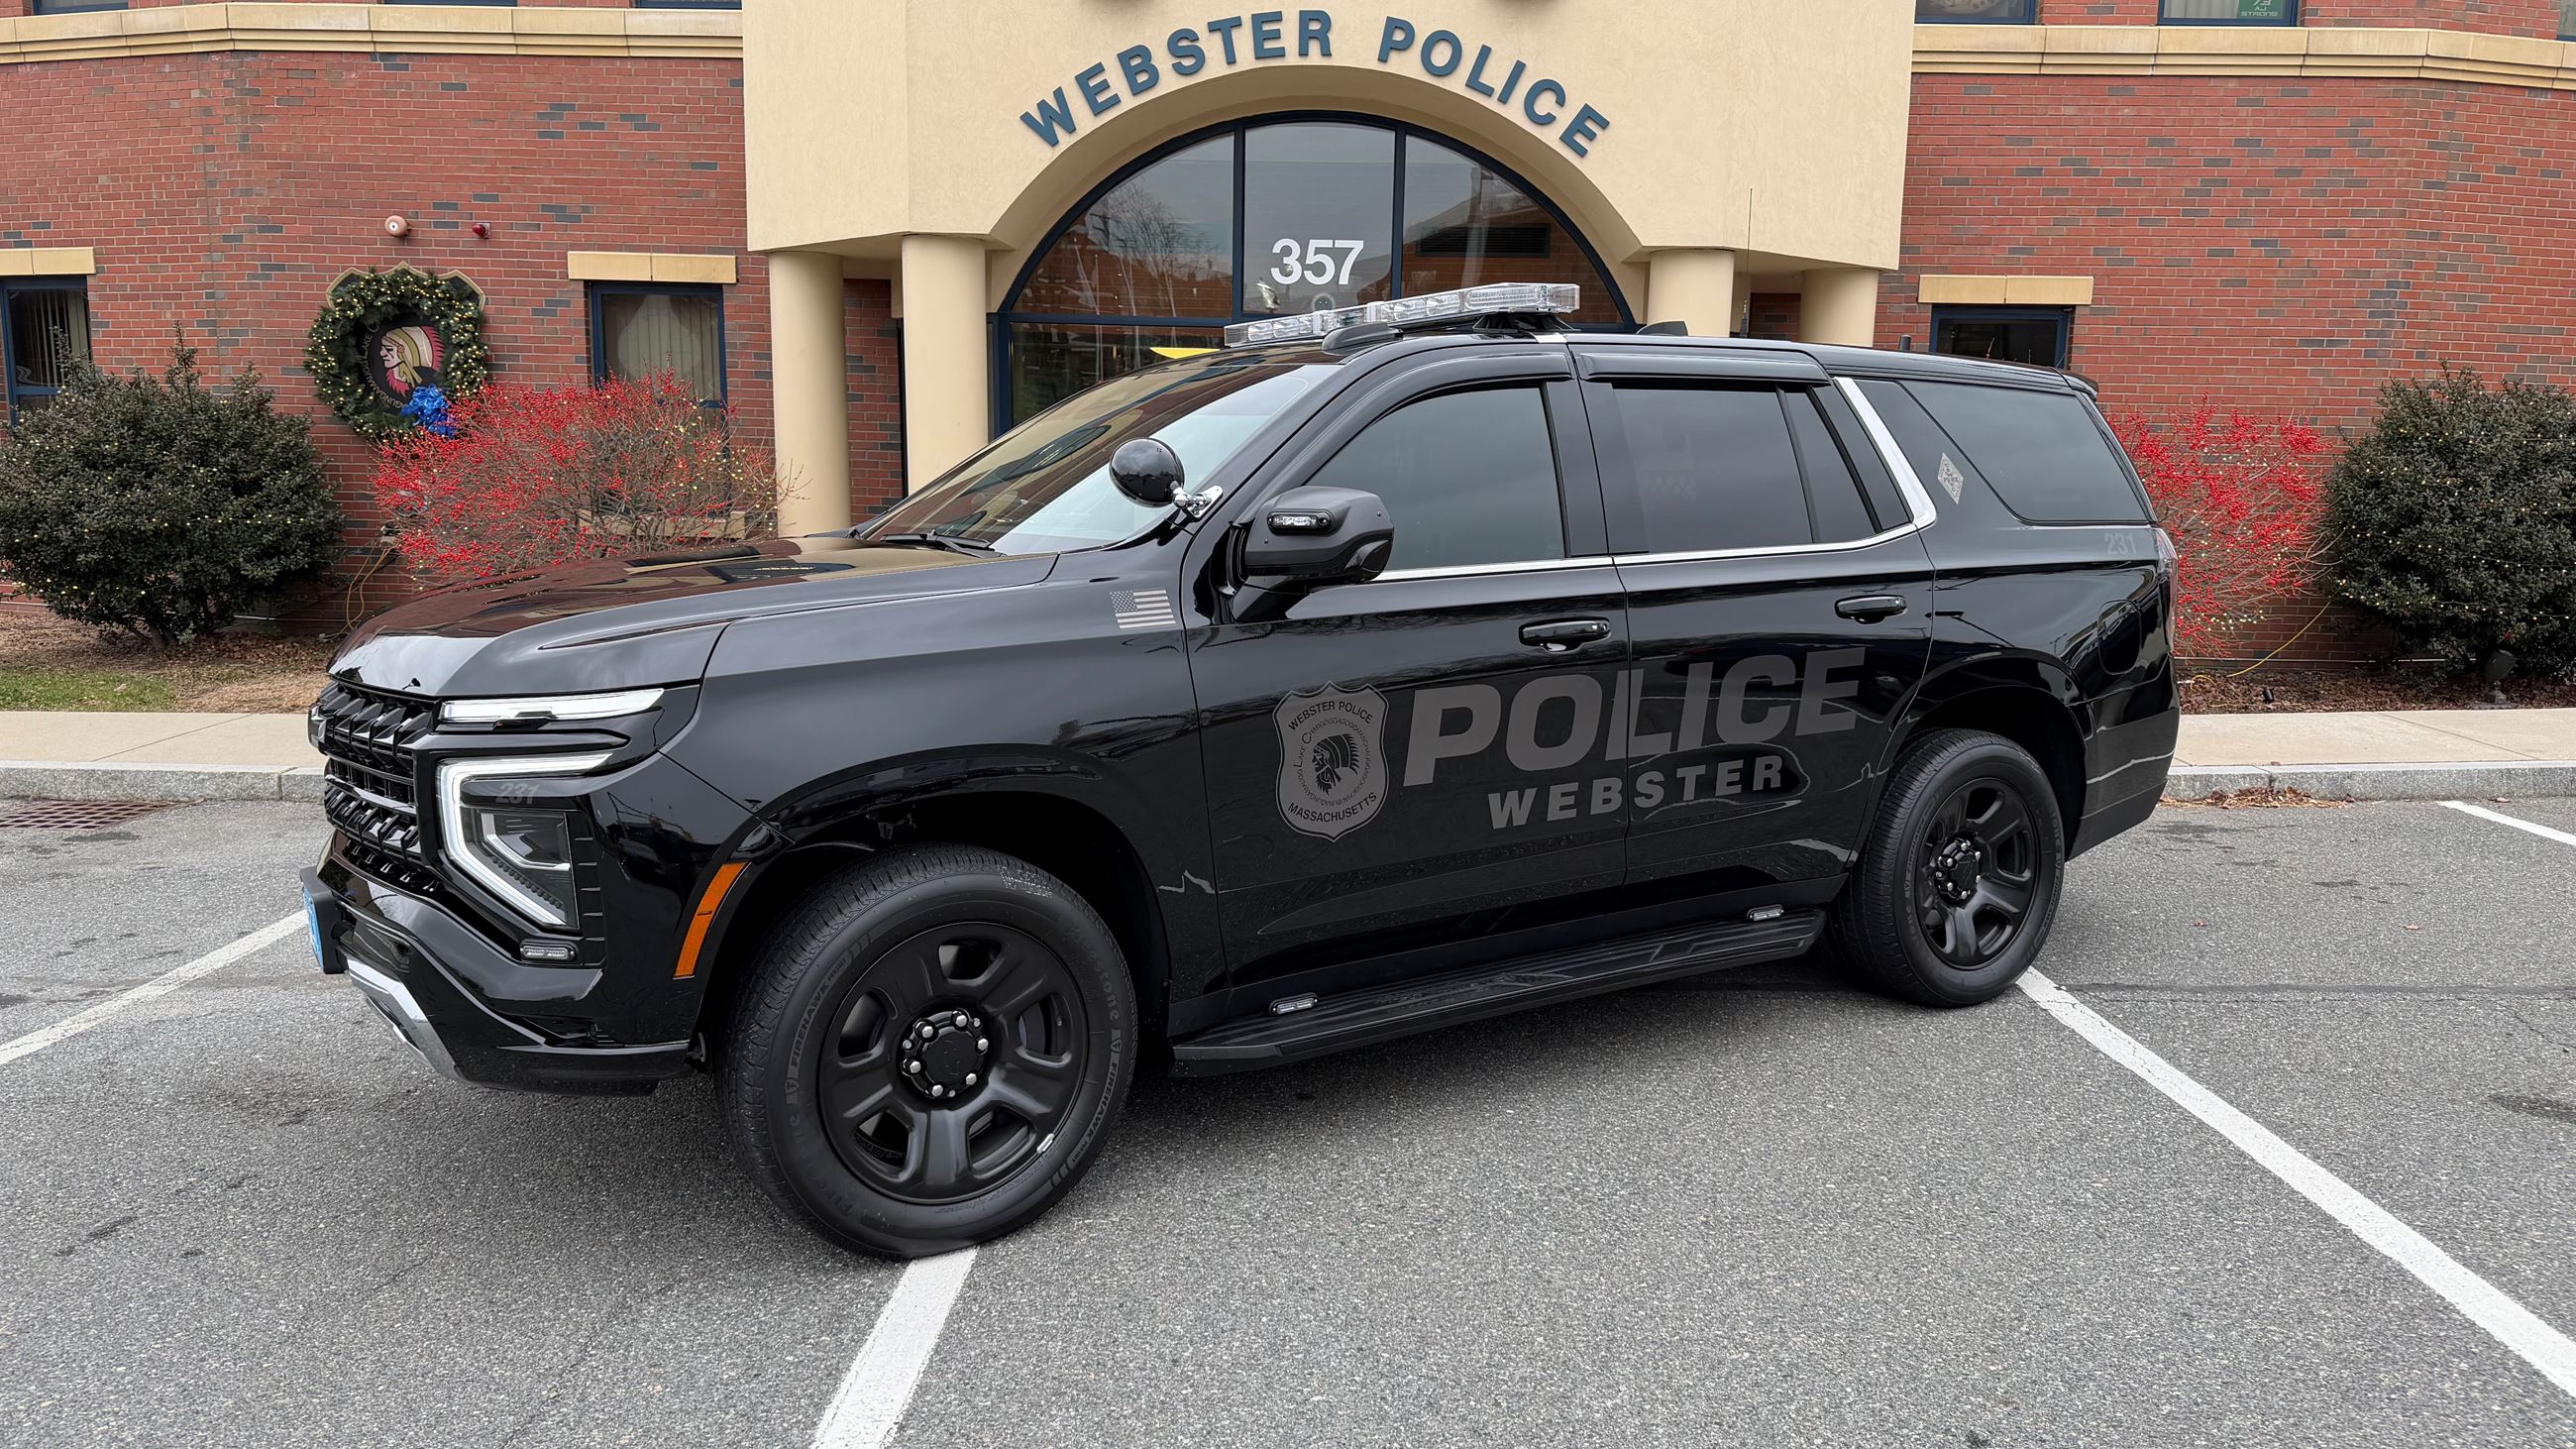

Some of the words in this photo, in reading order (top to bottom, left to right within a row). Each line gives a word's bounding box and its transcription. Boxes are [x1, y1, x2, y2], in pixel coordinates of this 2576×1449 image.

[1020, 10, 1333, 147] WEBSTER
[1377, 16, 1610, 158] POLICE
[1270, 239, 1364, 285] 357
[2103, 532, 2137, 555] 231
[1288, 701, 1336, 730] WEBSTER
[1339, 701, 1374, 724] POLICE
[1403, 647, 1866, 787] POLICE
[495, 783, 540, 805] 231
[1287, 792, 1377, 823] MASSACHUSETTS
[1488, 756, 1782, 829] WEBSTER
[791, 981, 828, 1068] FIREHAWK
[1085, 1060, 1119, 1142] FIREHAWK
